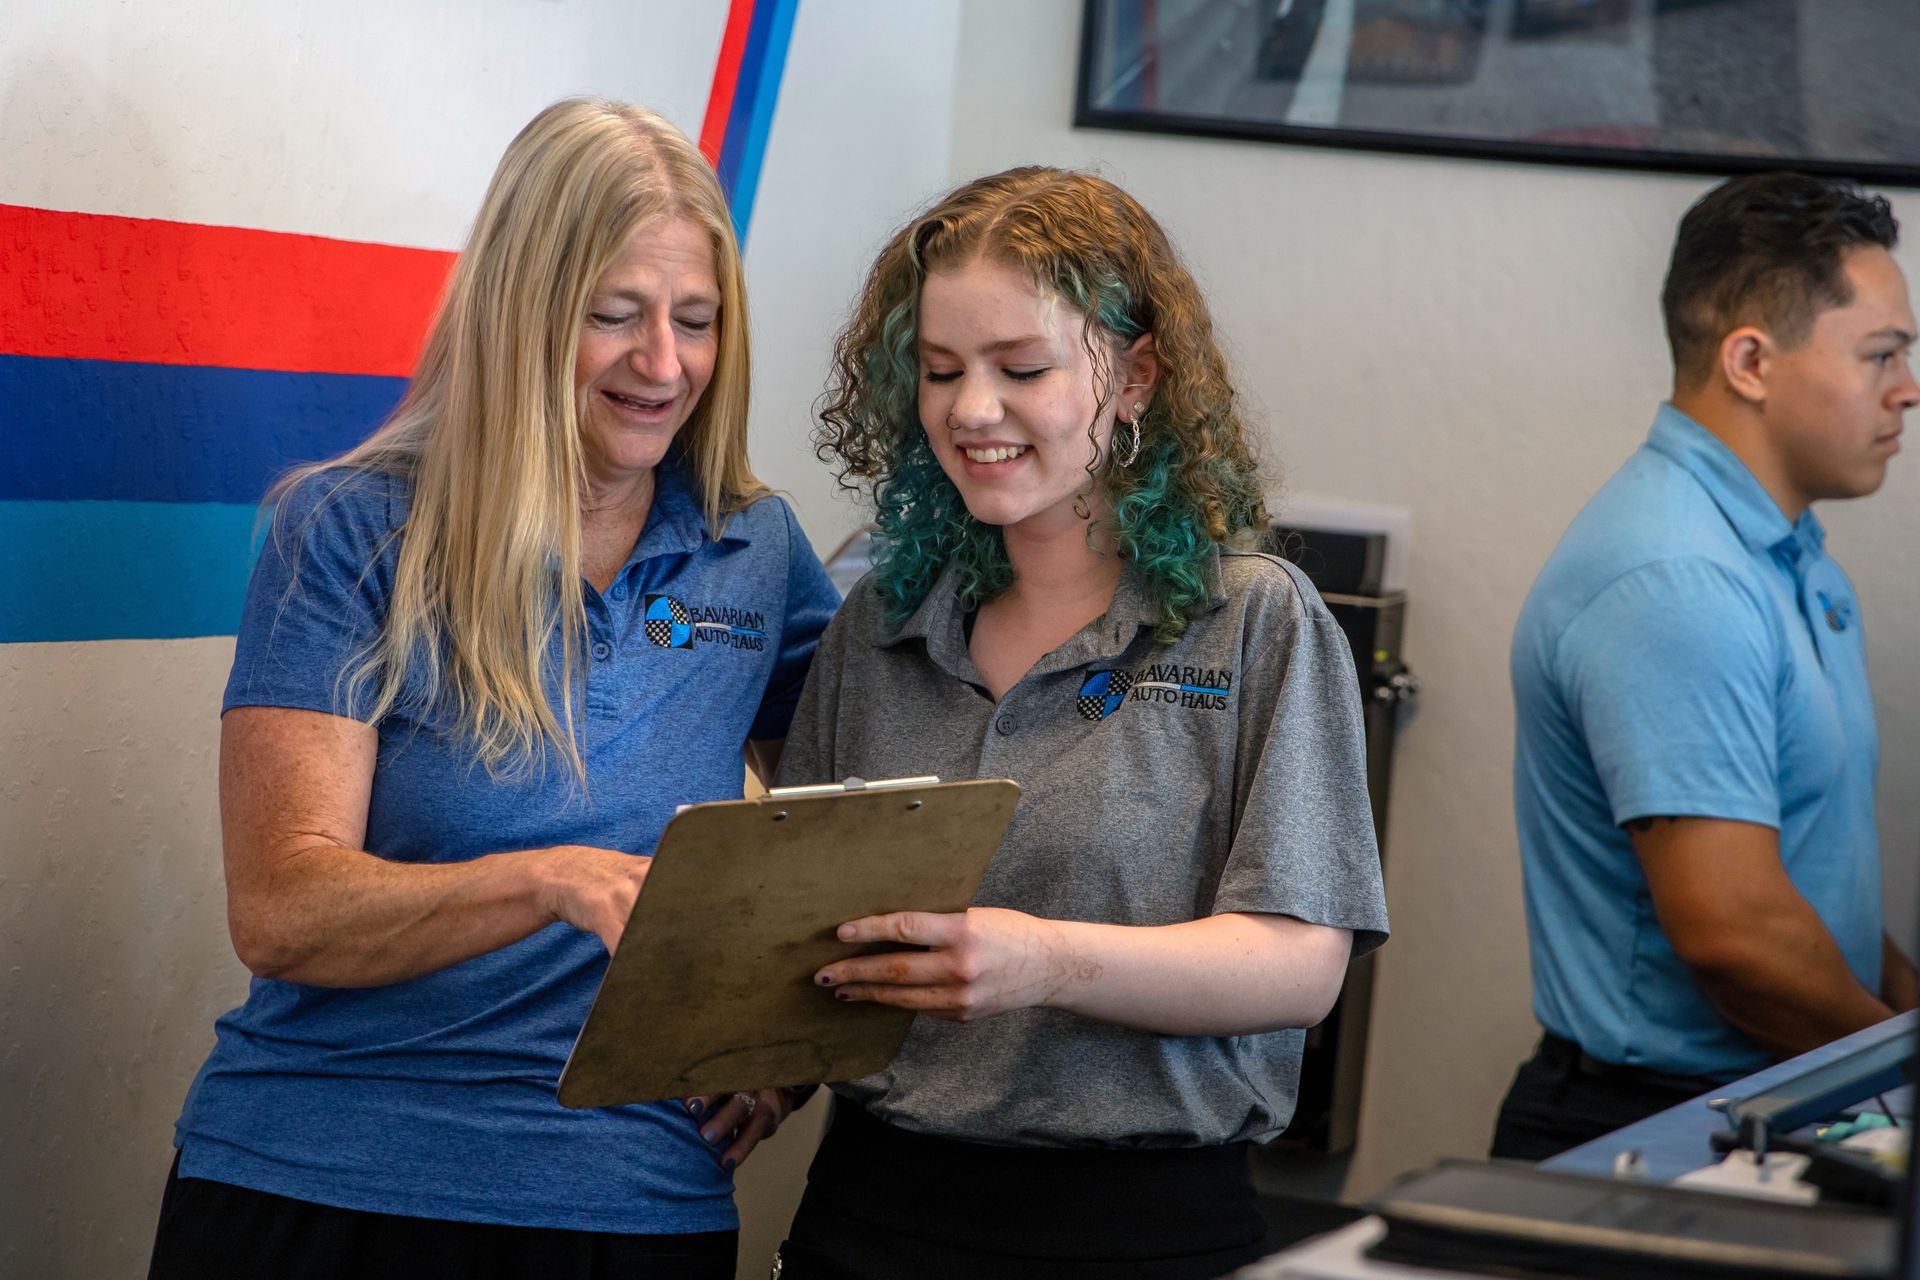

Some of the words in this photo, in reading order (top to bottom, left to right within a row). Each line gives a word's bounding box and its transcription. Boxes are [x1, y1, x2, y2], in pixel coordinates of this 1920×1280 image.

[690, 607, 764, 630] BAVARIAN
[695, 628, 730, 645] AUTO
[1134, 664, 1232, 690] BAVARIAN
[1129, 687, 1178, 704] AUTO
[1181, 692, 1227, 711] HAUS
